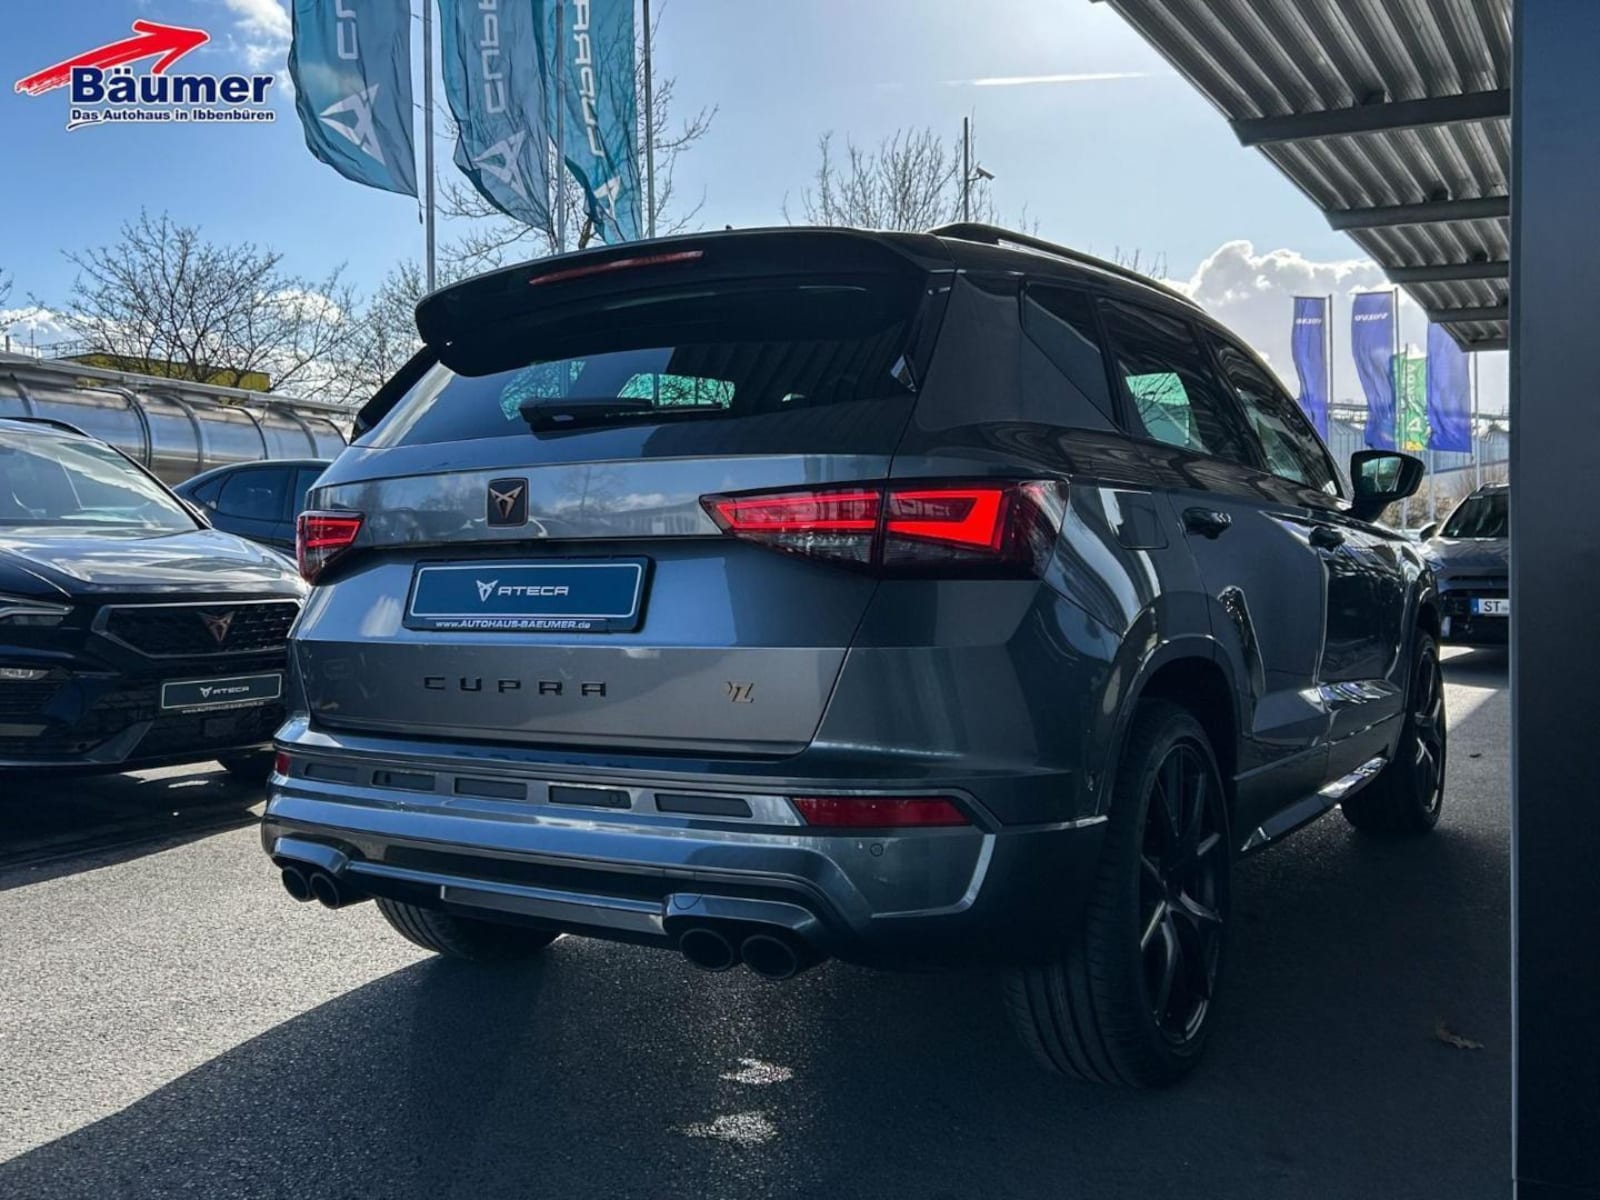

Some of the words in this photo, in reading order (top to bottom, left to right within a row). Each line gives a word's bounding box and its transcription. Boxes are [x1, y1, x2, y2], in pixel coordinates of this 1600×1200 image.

[497, 585, 569, 596] ATECA
[1484, 600, 1501, 612] ST
[435, 619, 591, 630] www.AUTOHAUS-BAEUMER.de
[423, 676, 607, 697] CUPRA
